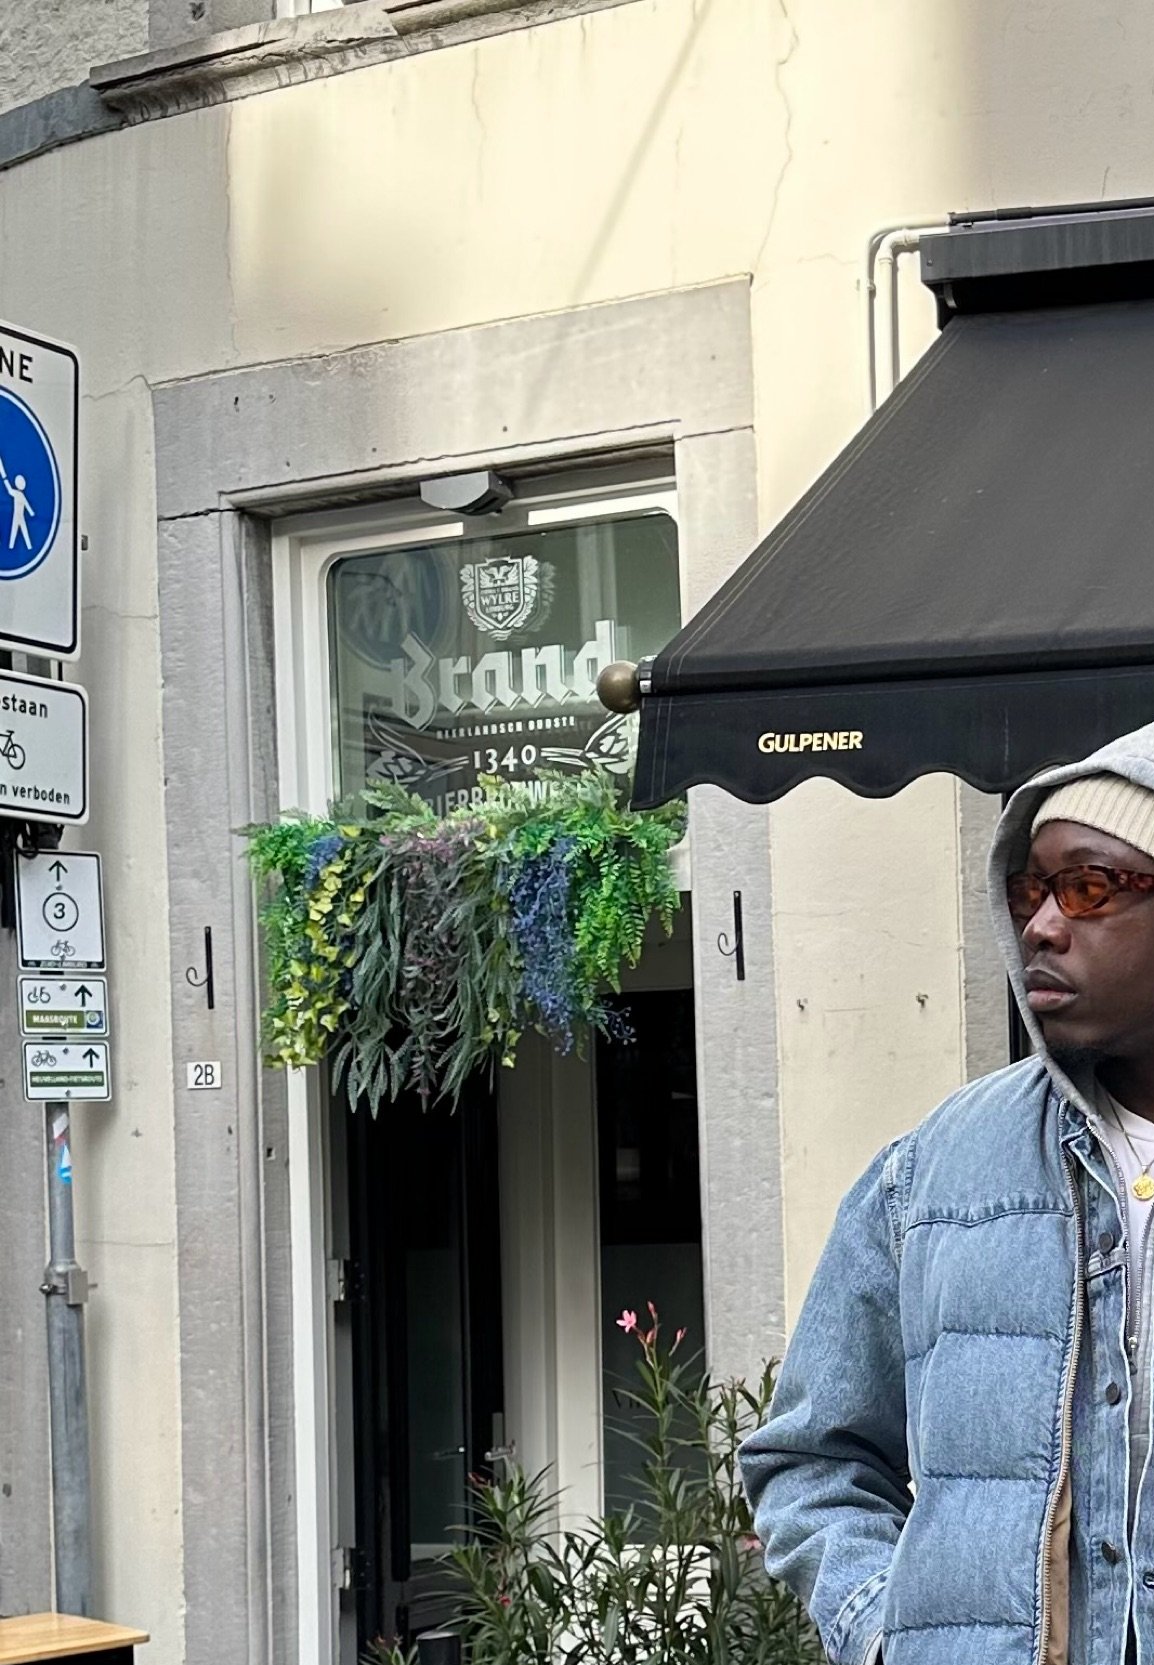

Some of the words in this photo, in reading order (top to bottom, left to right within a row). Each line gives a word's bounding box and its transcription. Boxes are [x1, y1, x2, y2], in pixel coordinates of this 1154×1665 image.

[0, 346, 33, 383] NE
[480, 591, 520, 606] WYLRE
[388, 619, 615, 732] Brand
[0, 693, 48, 718] staan
[528, 715, 575, 731] OUDSTE
[758, 730, 864, 753] GULPENER
[473, 744, 537, 774] 1340
[12, 785, 70, 805] verboden
[53, 902, 66, 919] 3
[194, 1063, 215, 1086] 2B
